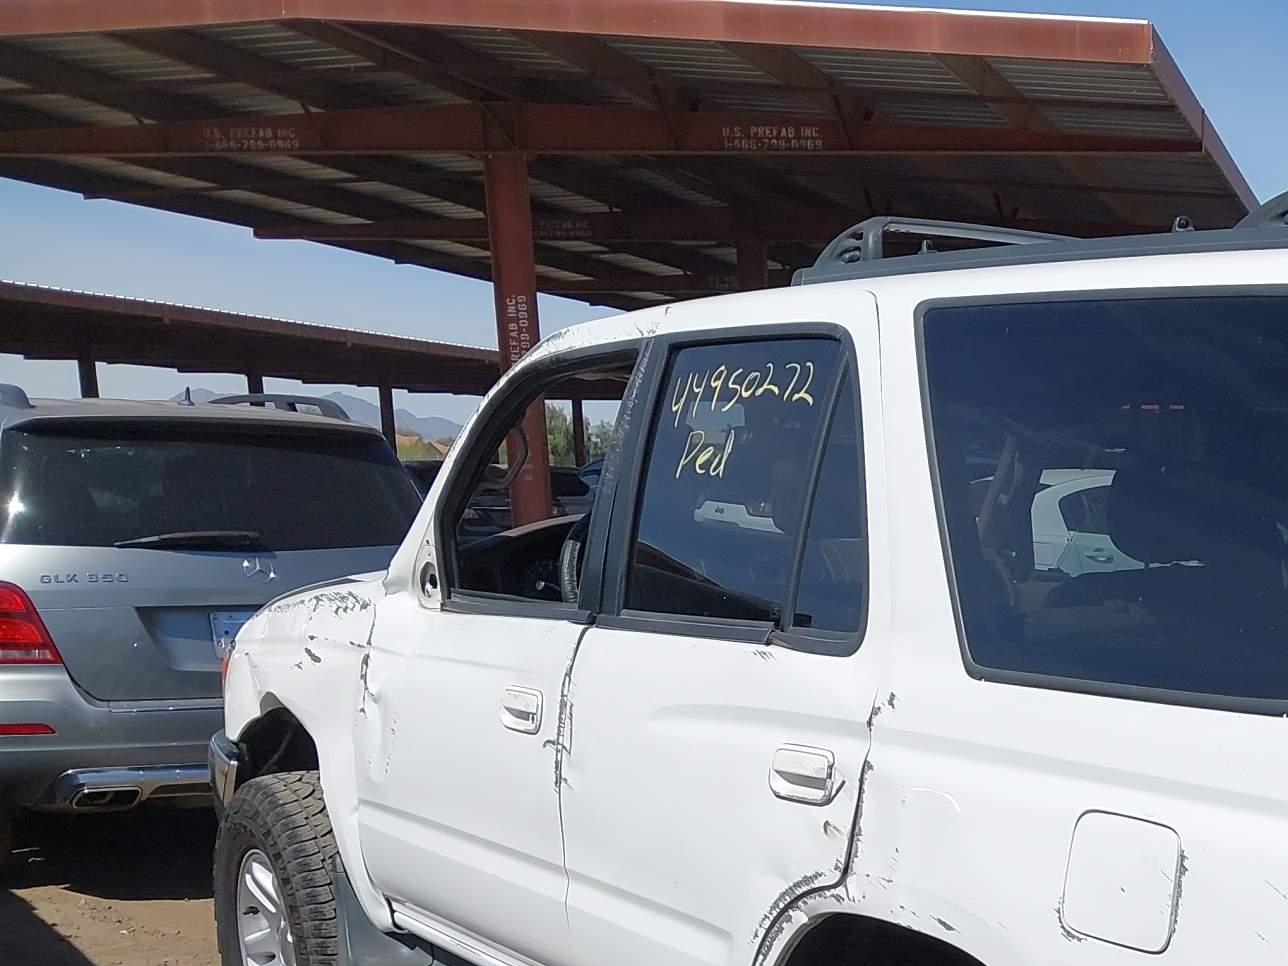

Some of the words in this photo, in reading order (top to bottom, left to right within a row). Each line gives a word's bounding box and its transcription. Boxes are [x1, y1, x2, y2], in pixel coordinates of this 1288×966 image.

[722, 126, 745, 138] U.S.
[750, 126, 796, 139] PREFAB
[671, 361, 814, 428] 44950272
[40, 573, 80, 585] GLK
[87, 573, 130, 584] 350
